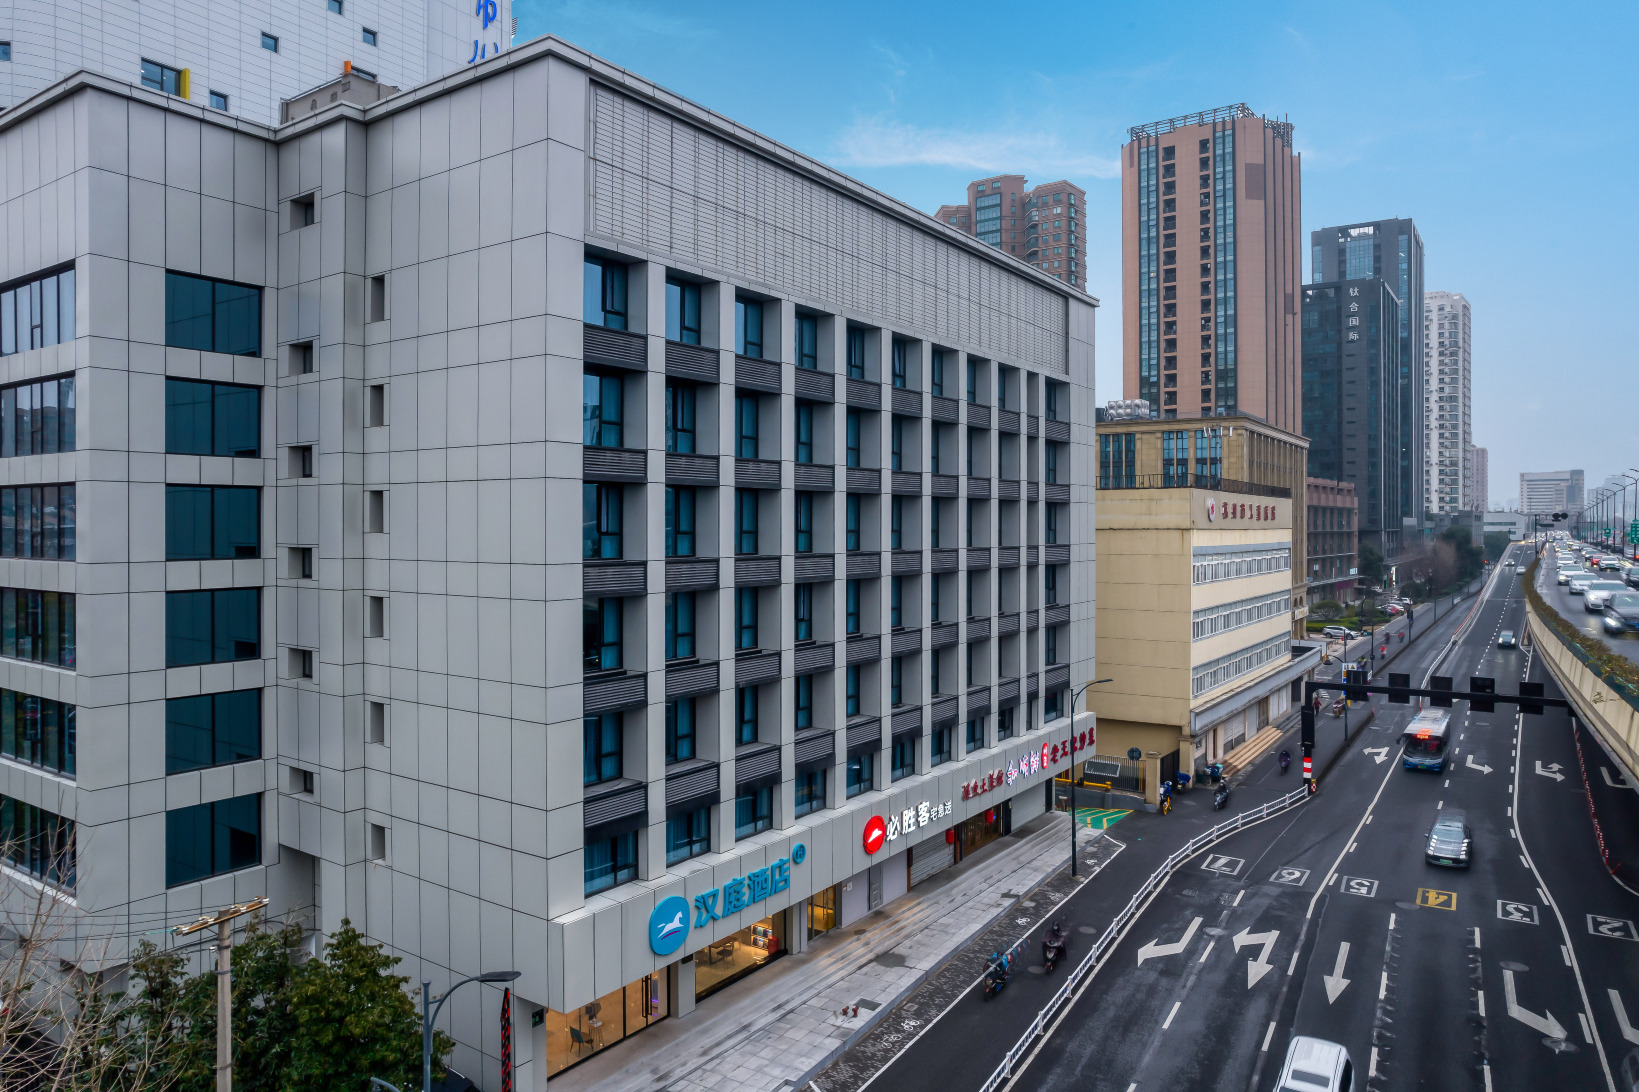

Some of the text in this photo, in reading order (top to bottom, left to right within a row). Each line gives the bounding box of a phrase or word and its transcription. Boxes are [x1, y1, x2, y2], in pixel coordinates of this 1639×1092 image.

[1349, 287, 1359, 340] 钛合国际
[886, 800, 952, 841] 必胜客 宅急送
[693, 858, 790, 928] 汉庭酒店
